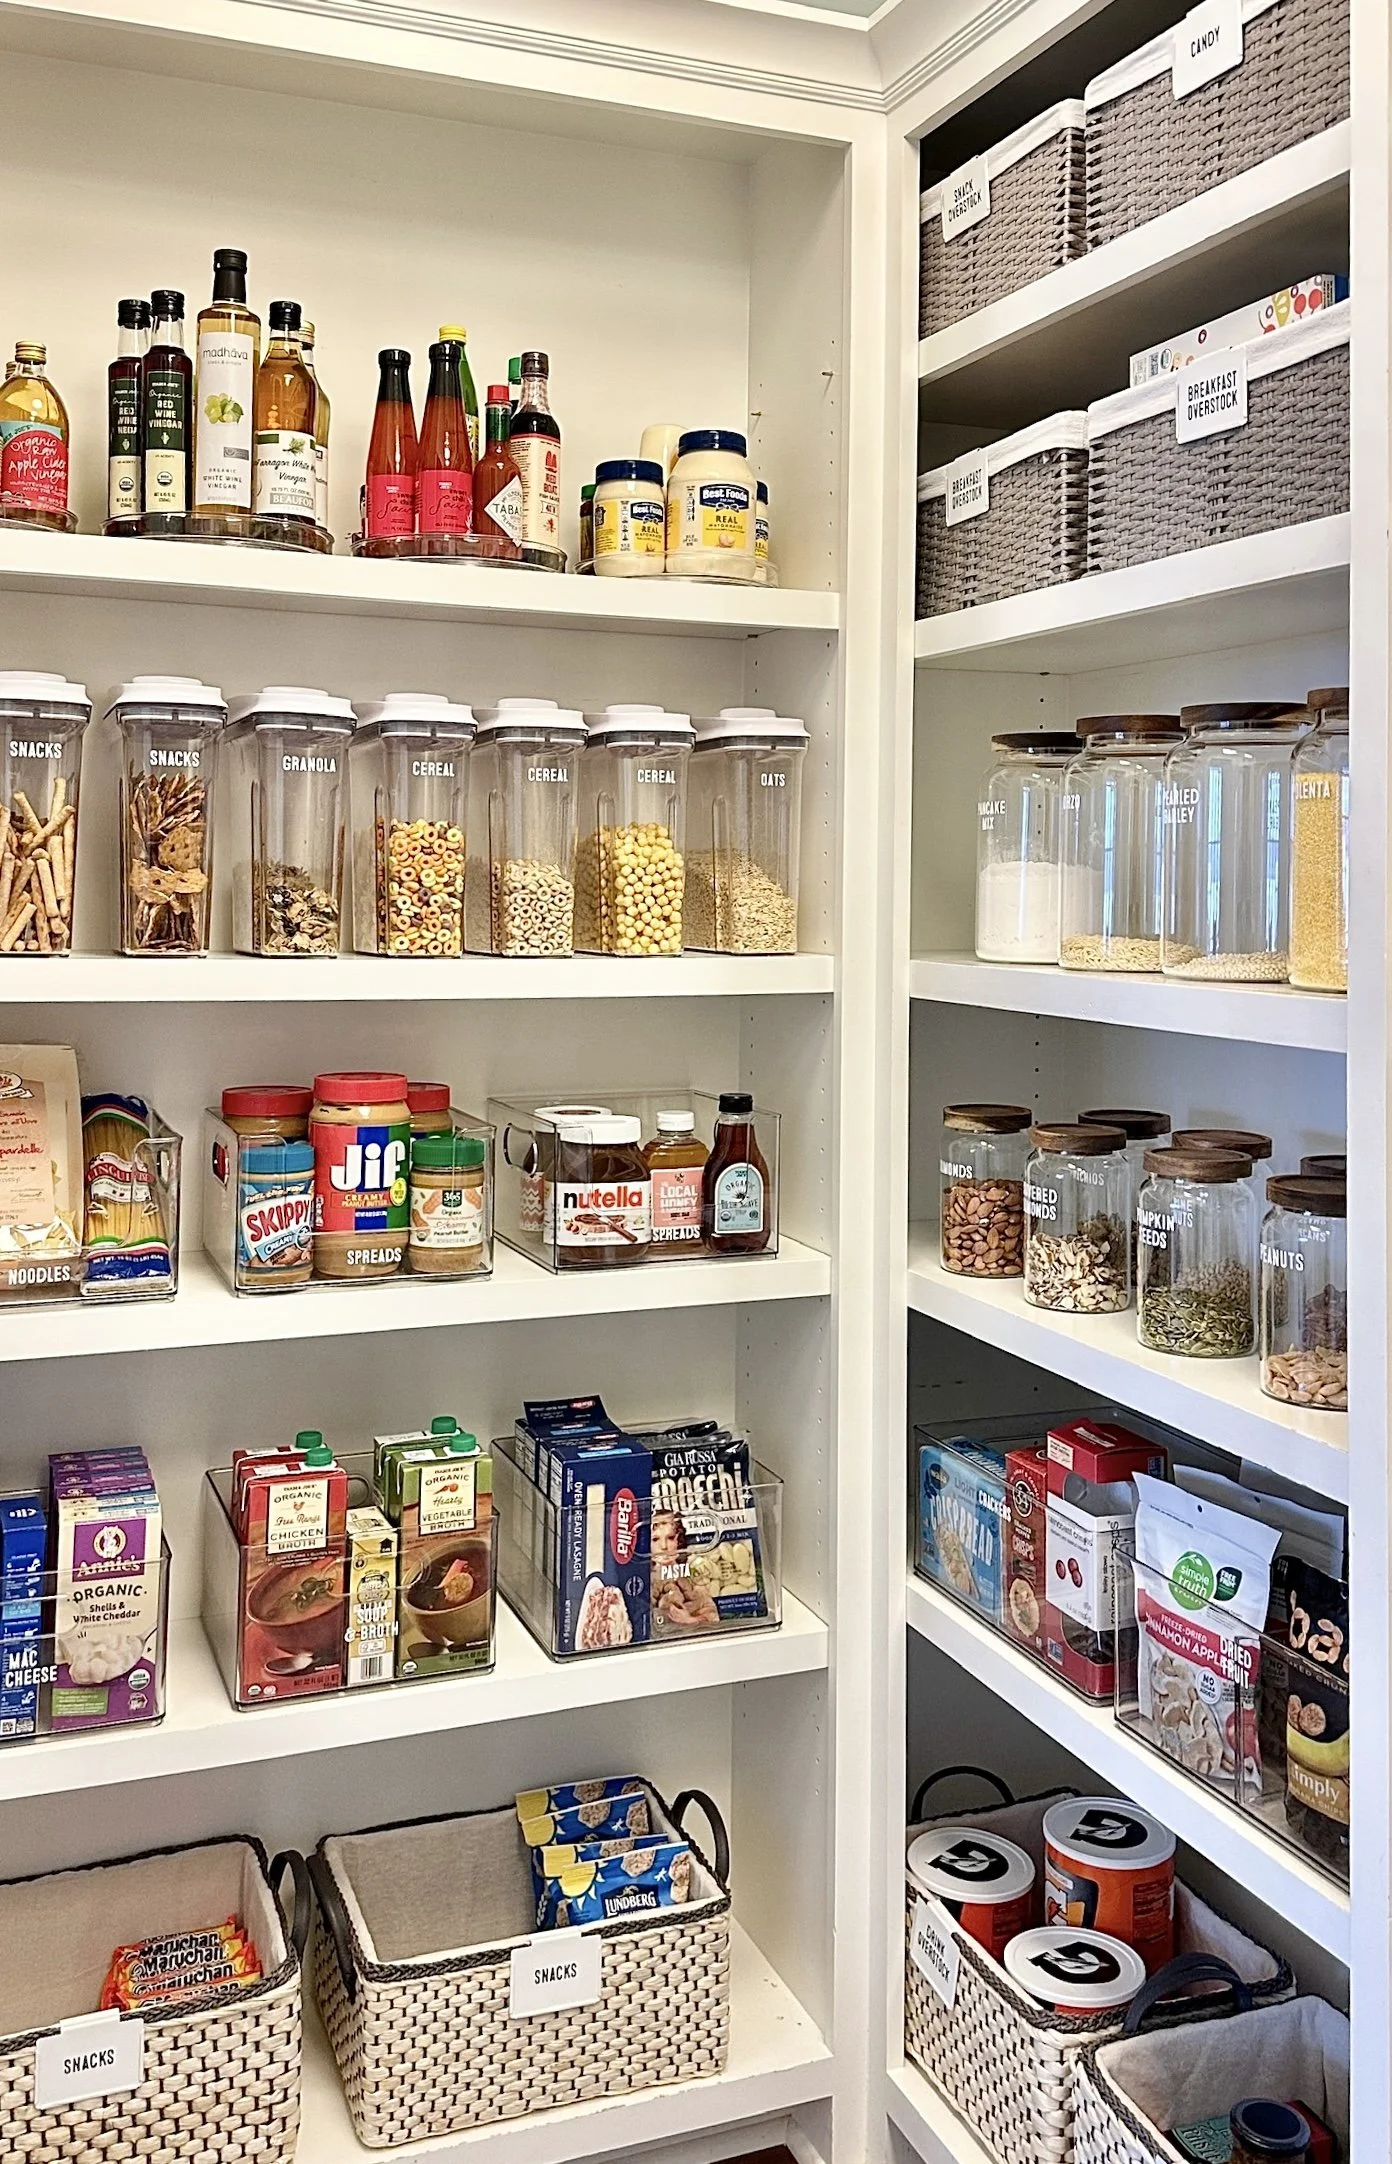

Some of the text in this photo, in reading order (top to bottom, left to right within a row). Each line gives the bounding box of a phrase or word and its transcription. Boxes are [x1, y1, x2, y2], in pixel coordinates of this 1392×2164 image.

[1191, 26, 1220, 58] CANDY
[954, 179, 974, 203] SNACK
[949, 189, 982, 222] OVERSTOCK
[1188, 370, 1237, 402] BREAKFAST
[157, 400, 174, 409] RED
[1188, 390, 1238, 420] OVERSTOCK
[149, 419, 182, 429] VINEGAR
[155, 410, 176, 419] WINE
[10, 436, 58, 454] Organic
[8, 454, 38, 478] Apple
[226, 475, 242, 483] WINE
[279, 471, 307, 483] Vinegar
[953, 468, 981, 494] BREAKFAST
[702, 488, 748, 502] Best Foods
[632, 504, 648, 514] Best
[716, 515, 738, 524] REAL
[641, 525, 659, 534] REAL
[8, 739, 62, 760] SNACKS
[149, 748, 200, 768] SNACKS
[282, 754, 336, 774] GRANOLA
[411, 760, 455, 779] CEREAL
[527, 766, 569, 784] CEREAL
[636, 767, 677, 785] CEREAL
[760, 771, 786, 788] OATS
[331, 1140, 406, 1191] Jif
[940, 1159, 974, 1180] MONDS
[344, 1193, 384, 1202] CREAMY
[443, 1192, 461, 1202] 365
[564, 1185, 643, 1209] nutella
[660, 1184, 698, 1199] LOCAL
[246, 1199, 310, 1242] SKIPPY
[652, 1226, 701, 1242] SPREADS
[264, 1234, 293, 1255] CREAMY
[347, 1247, 402, 1265] SPREADS
[8, 1266, 71, 1285] NOODLES
[665, 1450, 716, 1467] GIA RUSSA
[425, 1474, 470, 1486] ORGANIC
[659, 1463, 716, 1478] POTATO
[273, 1491, 322, 1503] ORGANIC
[433, 1495, 464, 1507] Hearty
[978, 1489, 1012, 1523] CRACKERS
[422, 1508, 472, 1522] VEGETABLE
[270, 1528, 324, 1542] CHICKEN
[617, 1497, 633, 1556] Barilla
[930, 1494, 993, 1567] CRISPBREAD
[77, 1554, 141, 1578] Annie's
[573, 1540, 583, 1581] LASAGNE
[661, 1563, 691, 1580] PASTA
[1180, 1565, 1210, 1586] simple
[73, 1583, 143, 1603] ORGANIC
[1177, 1575, 1207, 1599] truth
[89, 1601, 125, 1613] Shells &
[103, 1609, 141, 1621] Cheddar
[357, 1609, 387, 1625] SOUP
[344, 1621, 399, 1643] & BROTH
[1161, 1613, 1208, 1644] FREEZE-DRIED
[9, 1650, 38, 1669] MAC
[1220, 1635, 1252, 1669] DRIED
[5, 1665, 58, 1688] CHEESE
[1202, 1673, 1215, 1687] NO
[1221, 1658, 1250, 1690] FRUIT
[604, 1891, 657, 1918] LUNDBERG
[926, 1923, 946, 1958] DRINK
[143, 1944, 227, 1973] Maruchan
[534, 1962, 578, 1985] SNACKS
[63, 2048, 115, 2075] SNACKS
